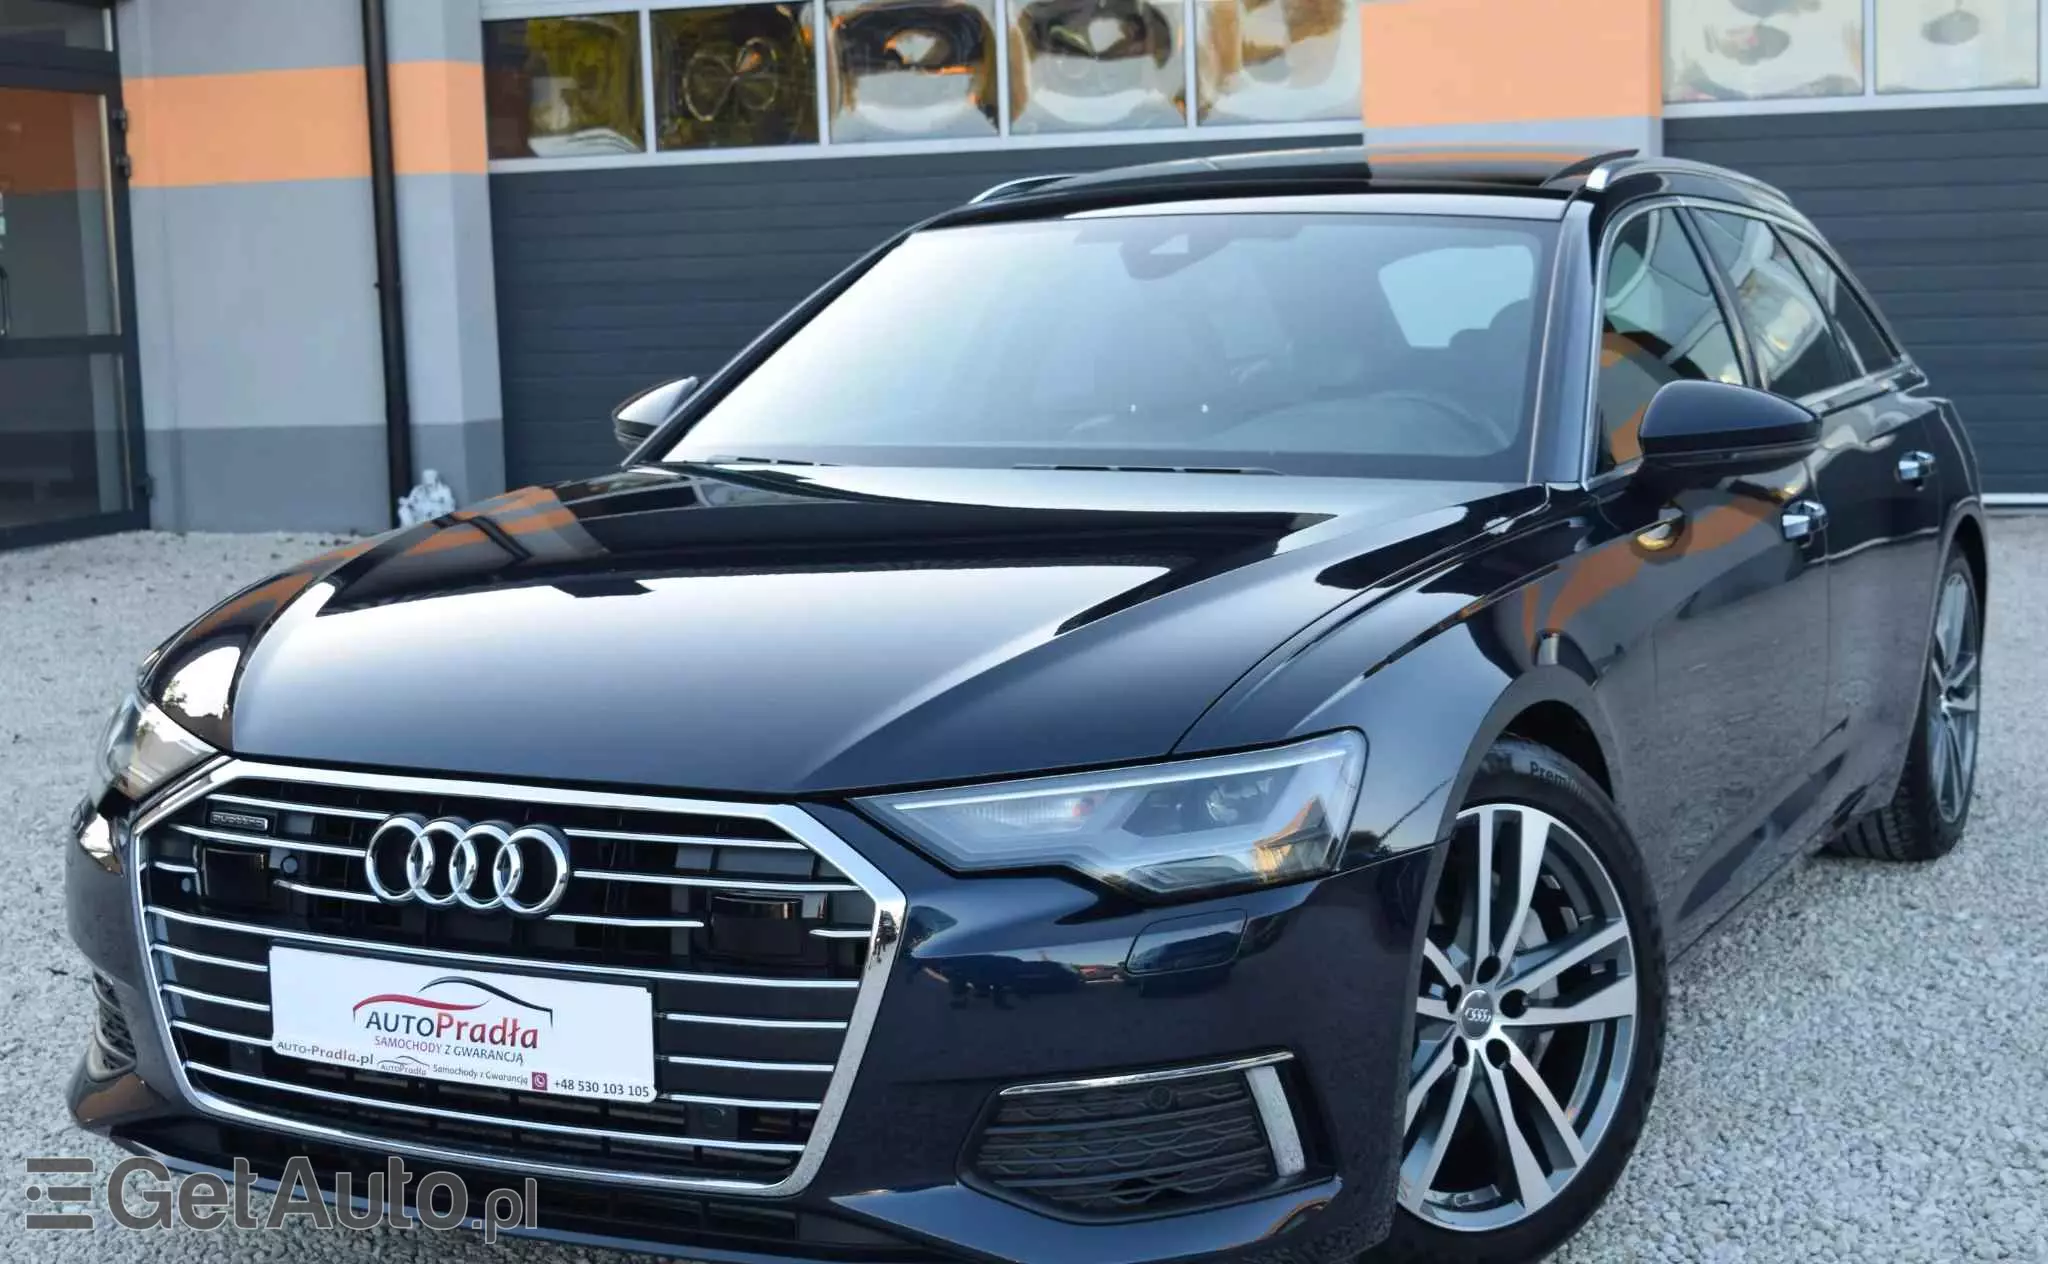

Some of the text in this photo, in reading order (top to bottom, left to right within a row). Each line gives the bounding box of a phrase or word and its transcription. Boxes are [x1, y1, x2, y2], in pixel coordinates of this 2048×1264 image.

[375, 1035, 525, 1066] SAMOCHODY Z GWARANCJĄ
[432, 1064, 479, 1080] Samochody
[554, 1079, 650, 1098] +48 530 103 105
